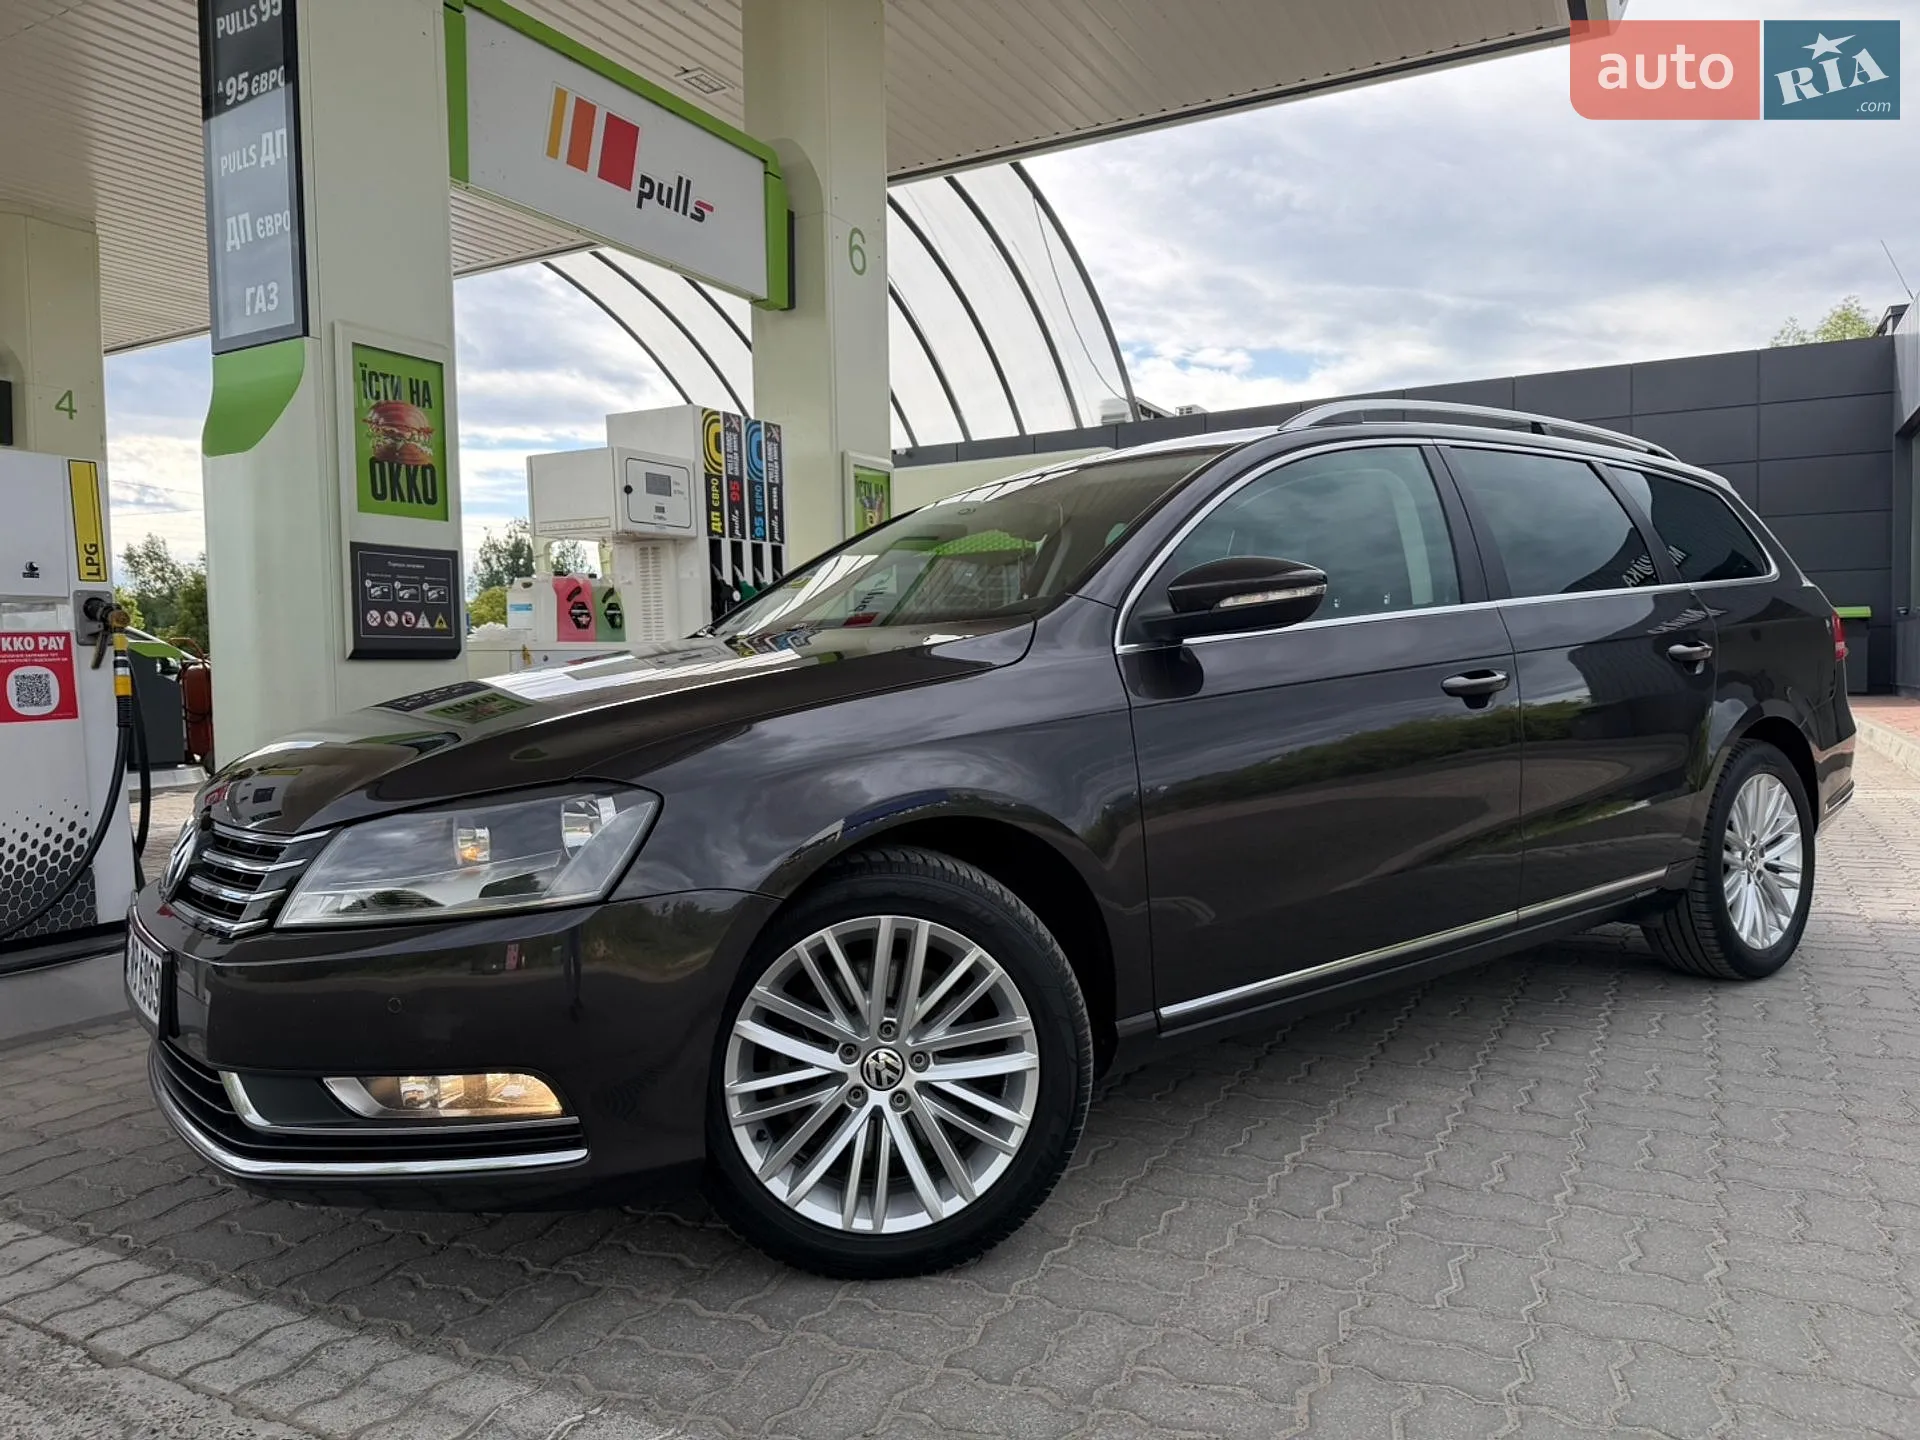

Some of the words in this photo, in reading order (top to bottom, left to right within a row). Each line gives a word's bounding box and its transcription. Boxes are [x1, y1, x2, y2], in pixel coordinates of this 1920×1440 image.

[216, 4, 258, 39] PULLS
[220, 144, 257, 177] PULLS
[260, 128, 288, 168] ДП
[636, 172, 714, 223] pulls
[226, 212, 253, 252] ДП
[849, 227, 866, 276] 6
[245, 281, 279, 316] ГАЗ
[55, 389, 77, 420] 4
[408, 377, 433, 409] НА
[729, 481, 741, 503] 95
[711, 511, 722, 533] ДП
[85, 543, 99, 577] LPG
[0, 636, 35, 652] KKO
[39, 635, 66, 651] PAY
